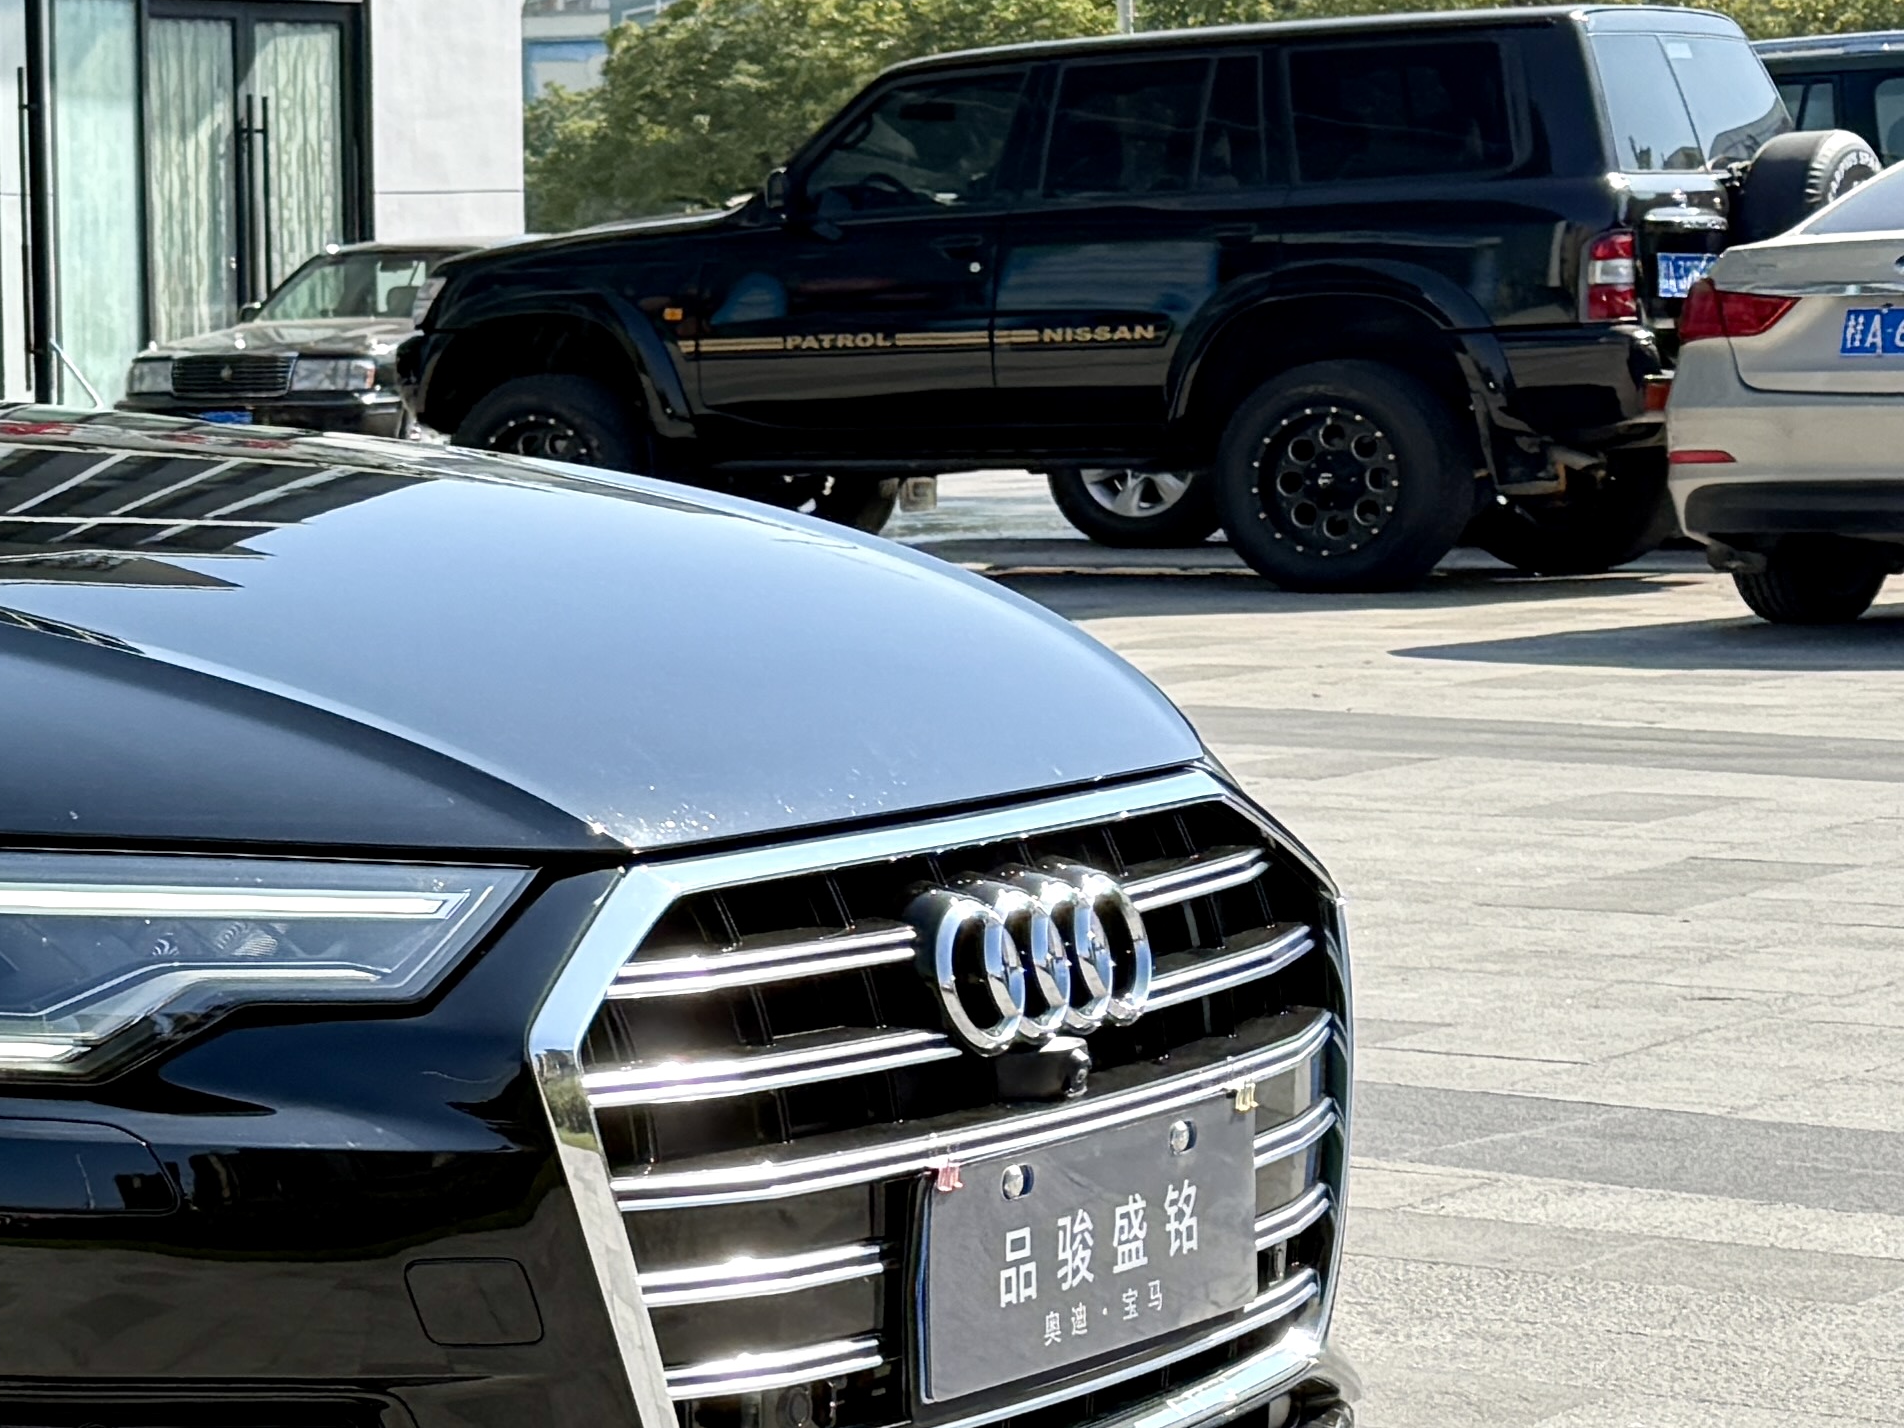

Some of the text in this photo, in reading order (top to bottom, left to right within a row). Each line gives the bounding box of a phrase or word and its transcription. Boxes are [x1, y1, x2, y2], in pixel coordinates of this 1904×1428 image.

[784, 331, 893, 351] PATROL
[1041, 324, 1156, 345] NISSAN
[999, 1178, 1199, 1309] 品骏盛铭
